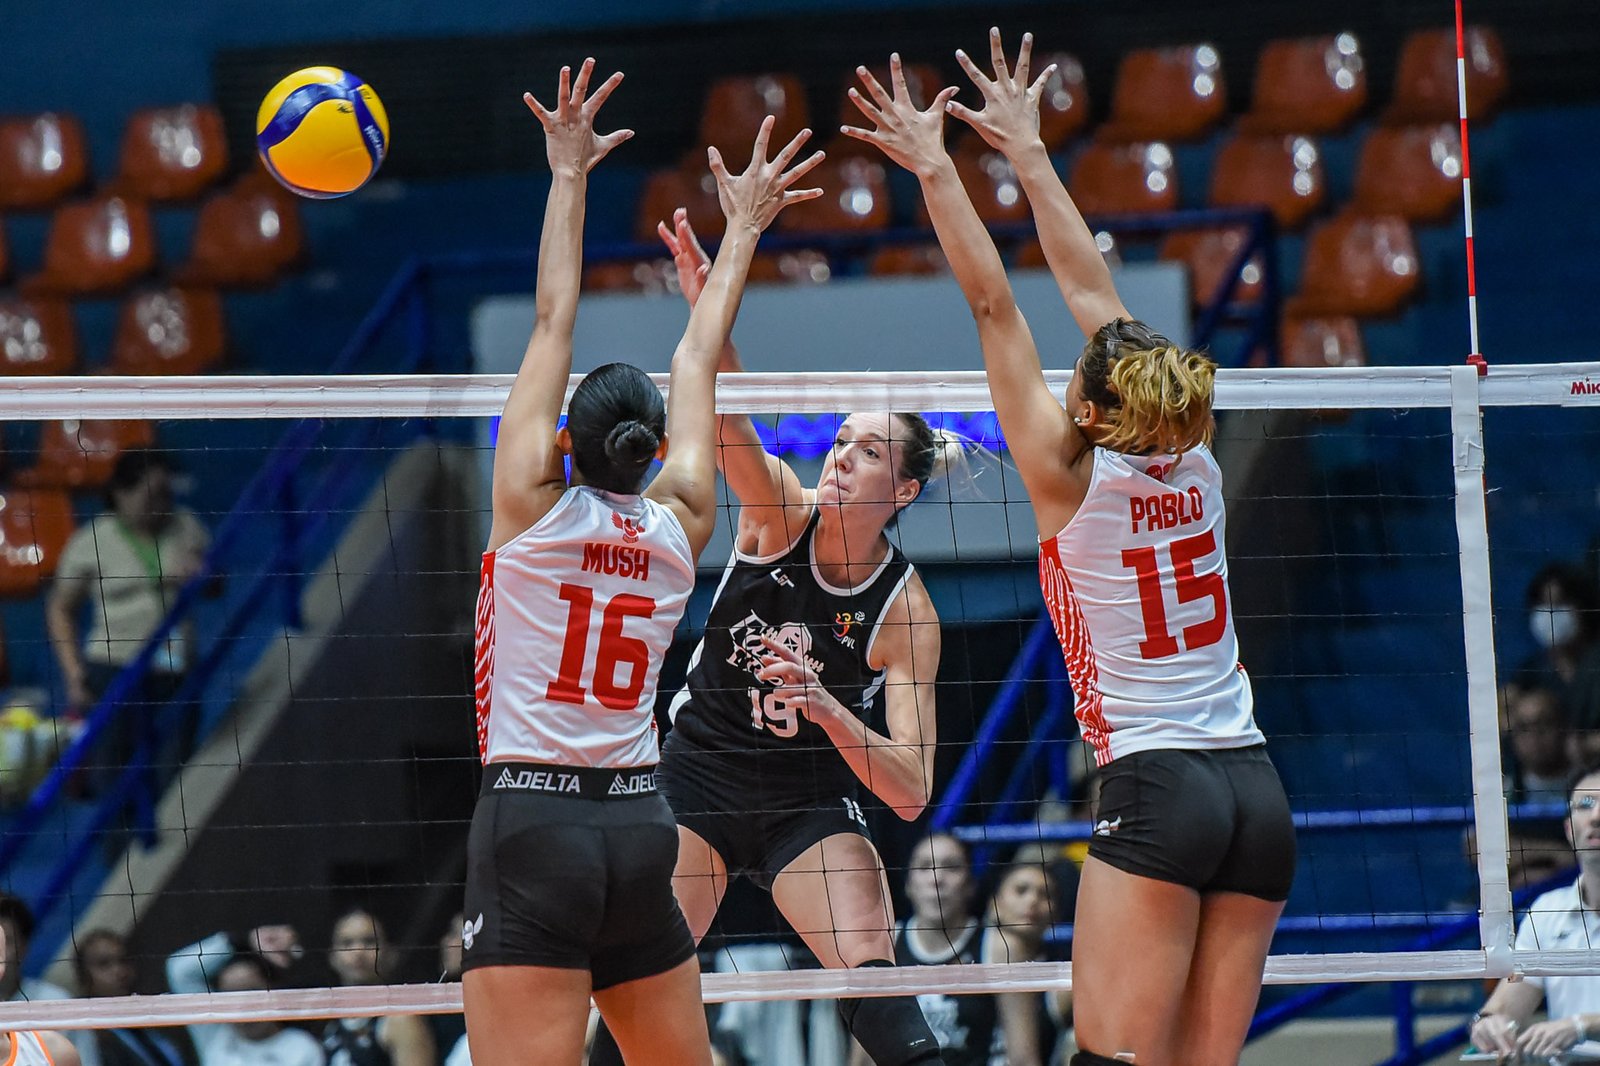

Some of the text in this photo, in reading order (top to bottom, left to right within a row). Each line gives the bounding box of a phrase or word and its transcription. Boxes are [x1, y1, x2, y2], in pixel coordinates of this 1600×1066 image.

[1129, 486, 1204, 534] PABLO
[581, 542, 651, 581] MUSA
[1120, 529, 1228, 660] 15
[545, 582, 657, 711] 16
[748, 686, 799, 738] 19
